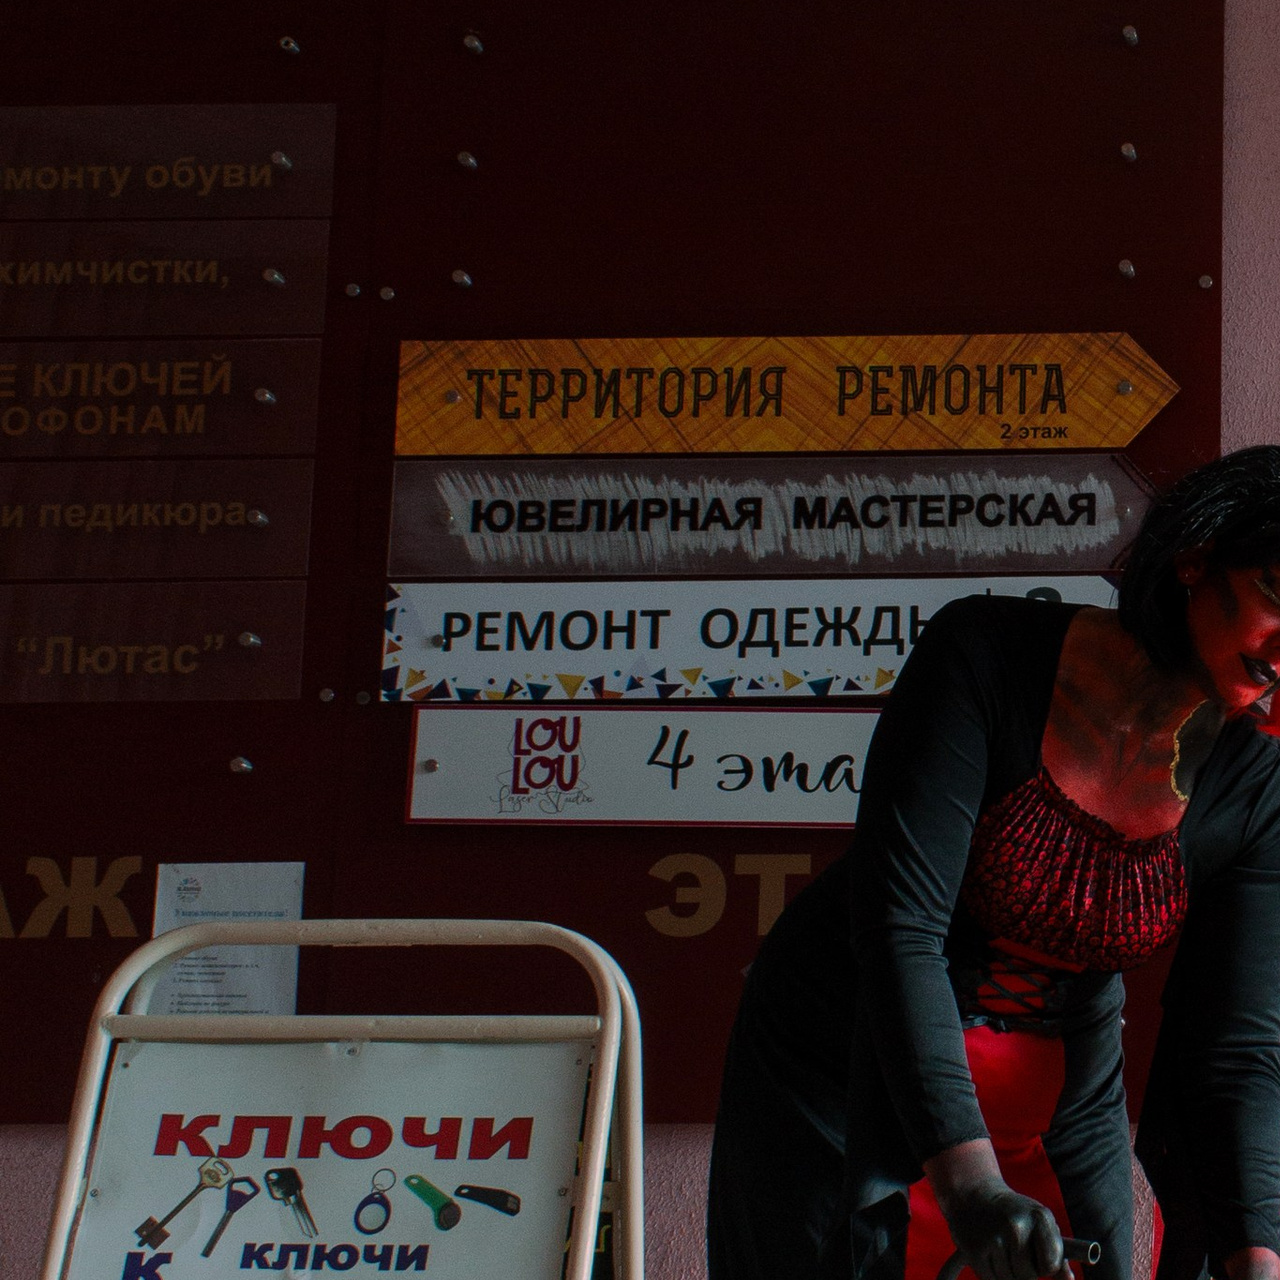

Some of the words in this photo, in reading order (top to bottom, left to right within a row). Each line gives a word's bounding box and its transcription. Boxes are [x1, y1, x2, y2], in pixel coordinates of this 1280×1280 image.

[145, 156, 273, 197] обуви
[32, 353, 233, 398] КЛЮЧЕЙ
[467, 367, 786, 420] ТЕРРИТОРИЯ
[837, 364, 1067, 416] РЕМОНТА
[1000, 423, 1013, 439] 2
[1018, 425, 1068, 440] этаж
[38, 501, 247, 534] педикюра
[470, 497, 763, 534] ЮВЕЛИРНАЯ
[793, 492, 1097, 530] МАСТЕРСКАЯ
[442, 609, 671, 652] РЕМОНТ
[513, 715, 581, 756] LOU
[511, 754, 580, 795] LOU
[648, 724, 694, 790] 4
